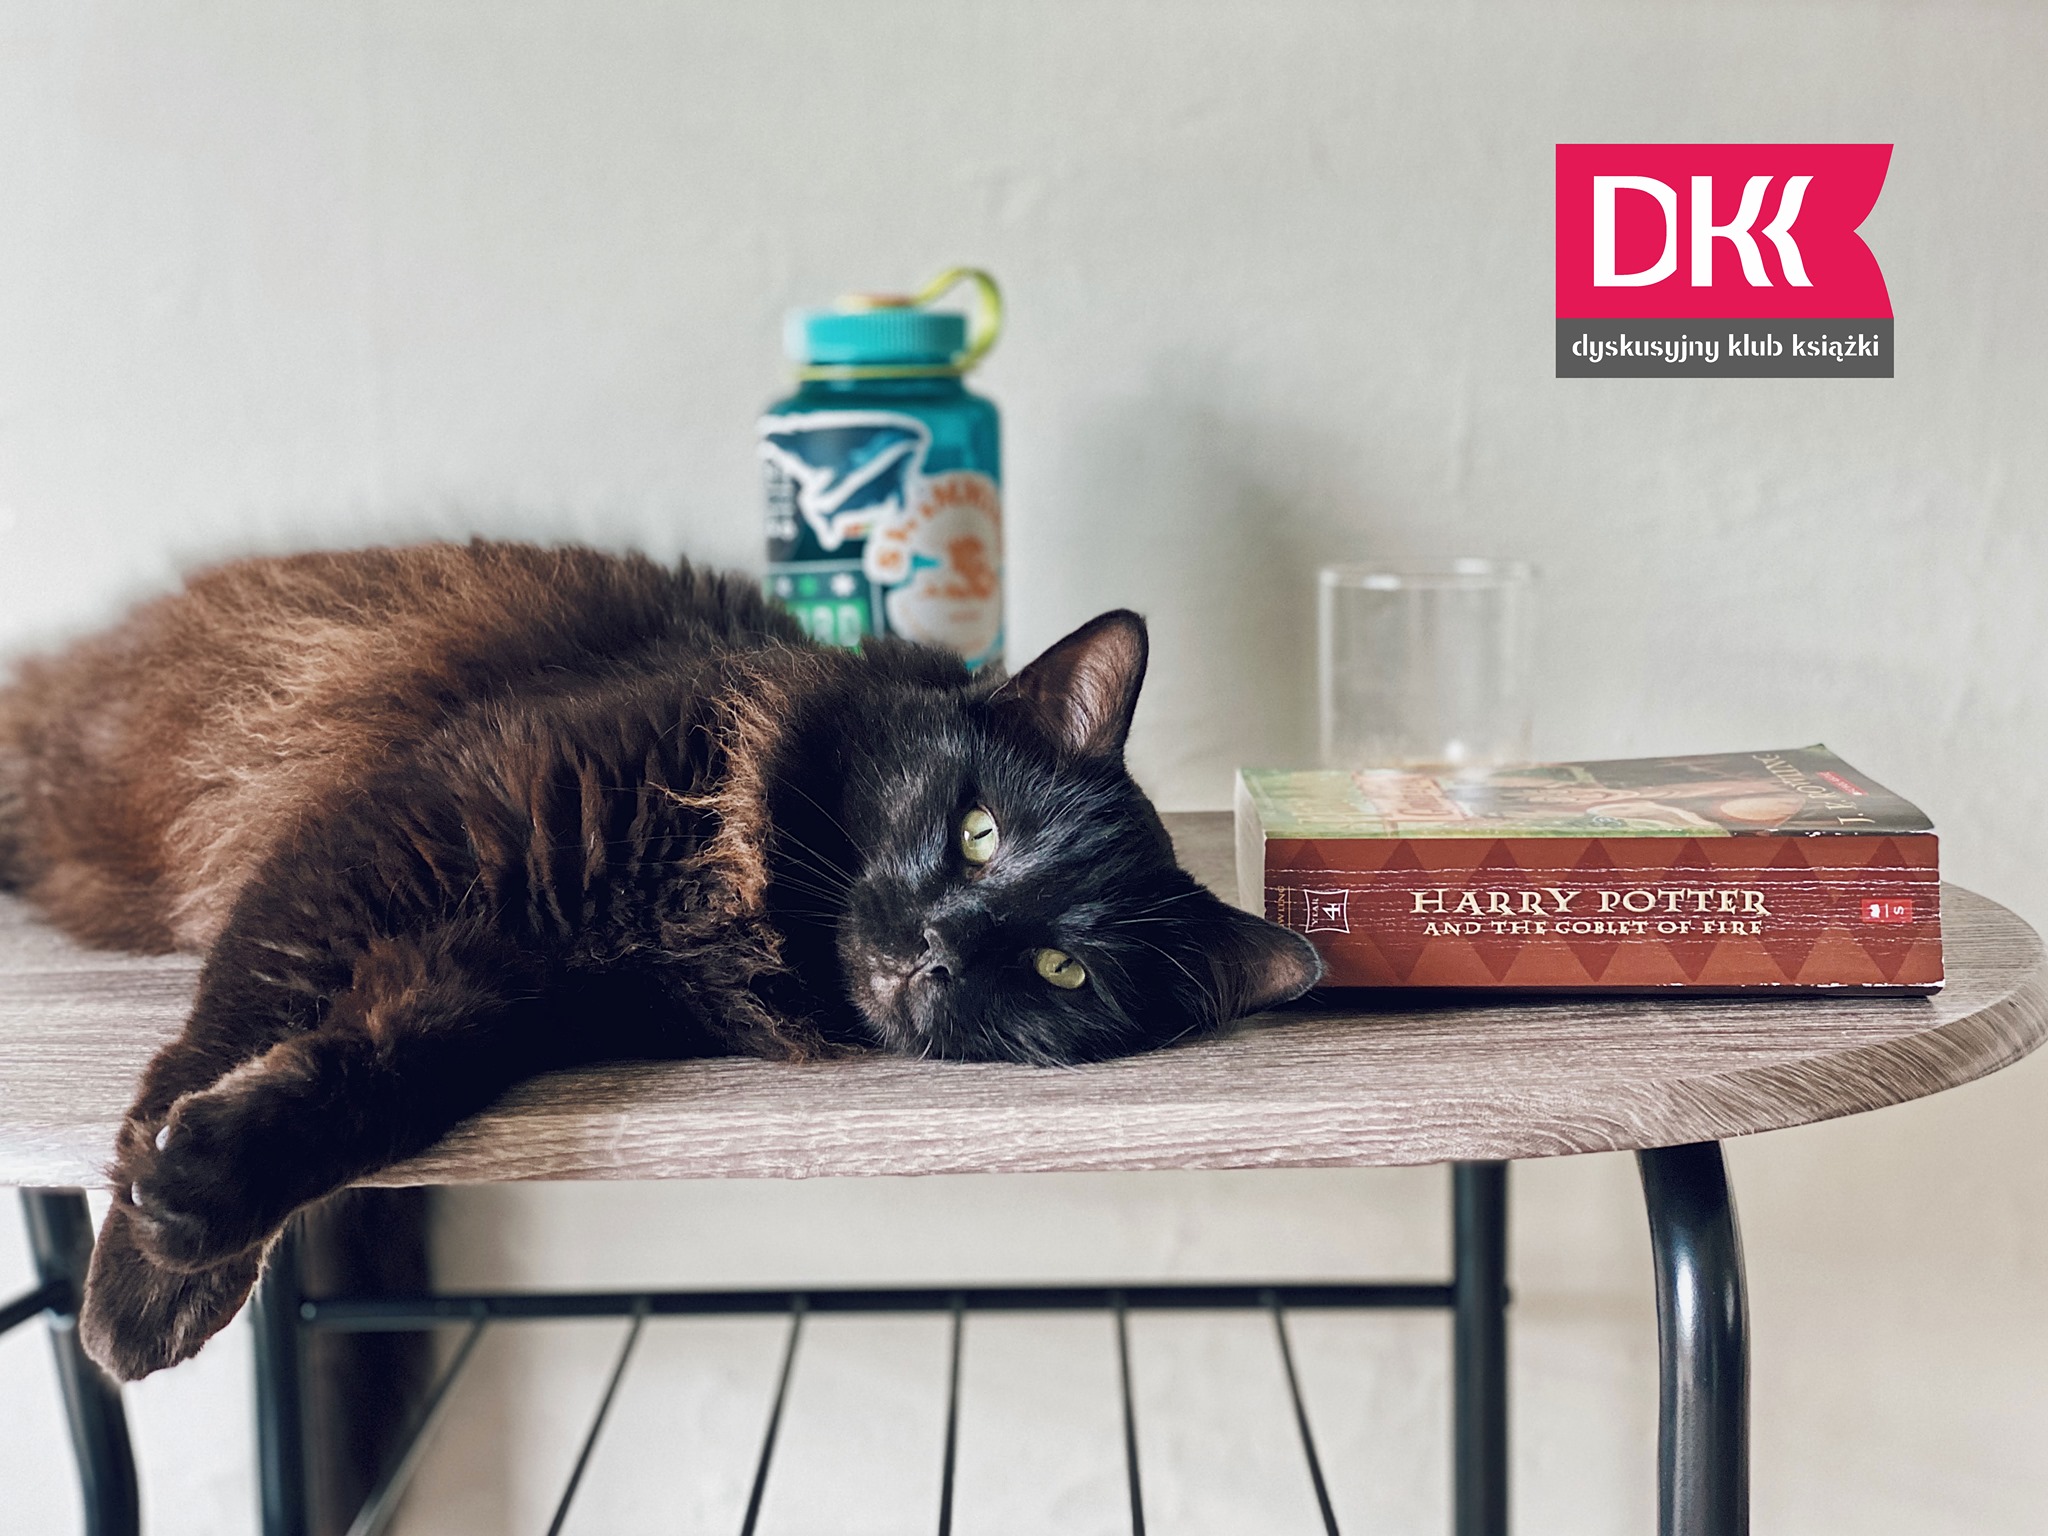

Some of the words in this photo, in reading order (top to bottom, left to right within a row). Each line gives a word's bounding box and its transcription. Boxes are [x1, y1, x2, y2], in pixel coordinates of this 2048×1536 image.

[1311, 897, 1320, 927] YEAR
[1321, 902, 1341, 921] 4
[1409, 887, 1581, 916] HARRY
[1597, 888, 1772, 916] POTTER
[1423, 921, 1482, 936] AND
[1491, 919, 1547, 936] THE
[1555, 920, 1649, 936] GOBLET
[1657, 920, 1692, 934] OF
[1702, 920, 1763, 936] FIRE
